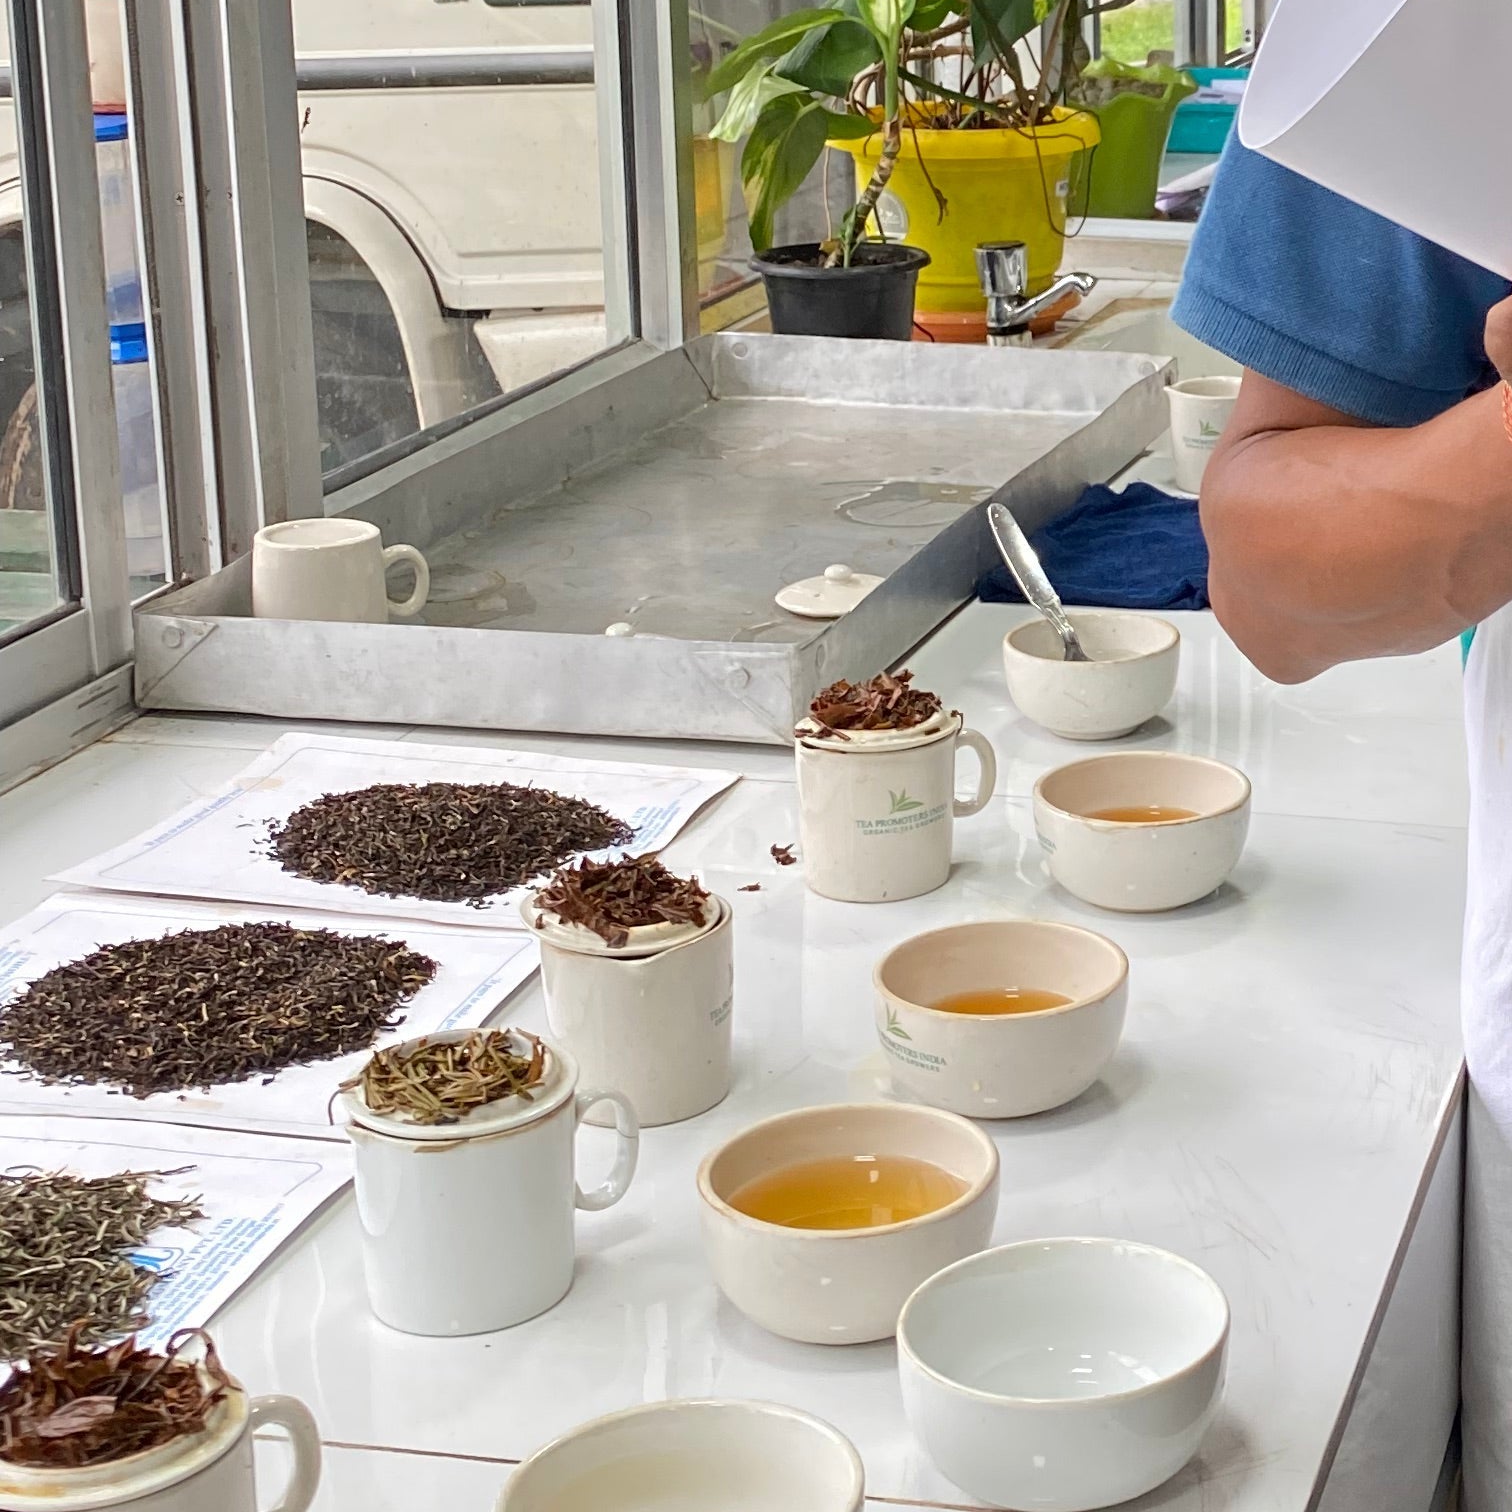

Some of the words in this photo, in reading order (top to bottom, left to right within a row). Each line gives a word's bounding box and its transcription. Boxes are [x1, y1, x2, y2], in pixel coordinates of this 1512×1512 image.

[856, 819, 874, 829] TEA
[875, 810, 929, 828] PROMOTERS
[919, 1052, 947, 1066] INDIA
